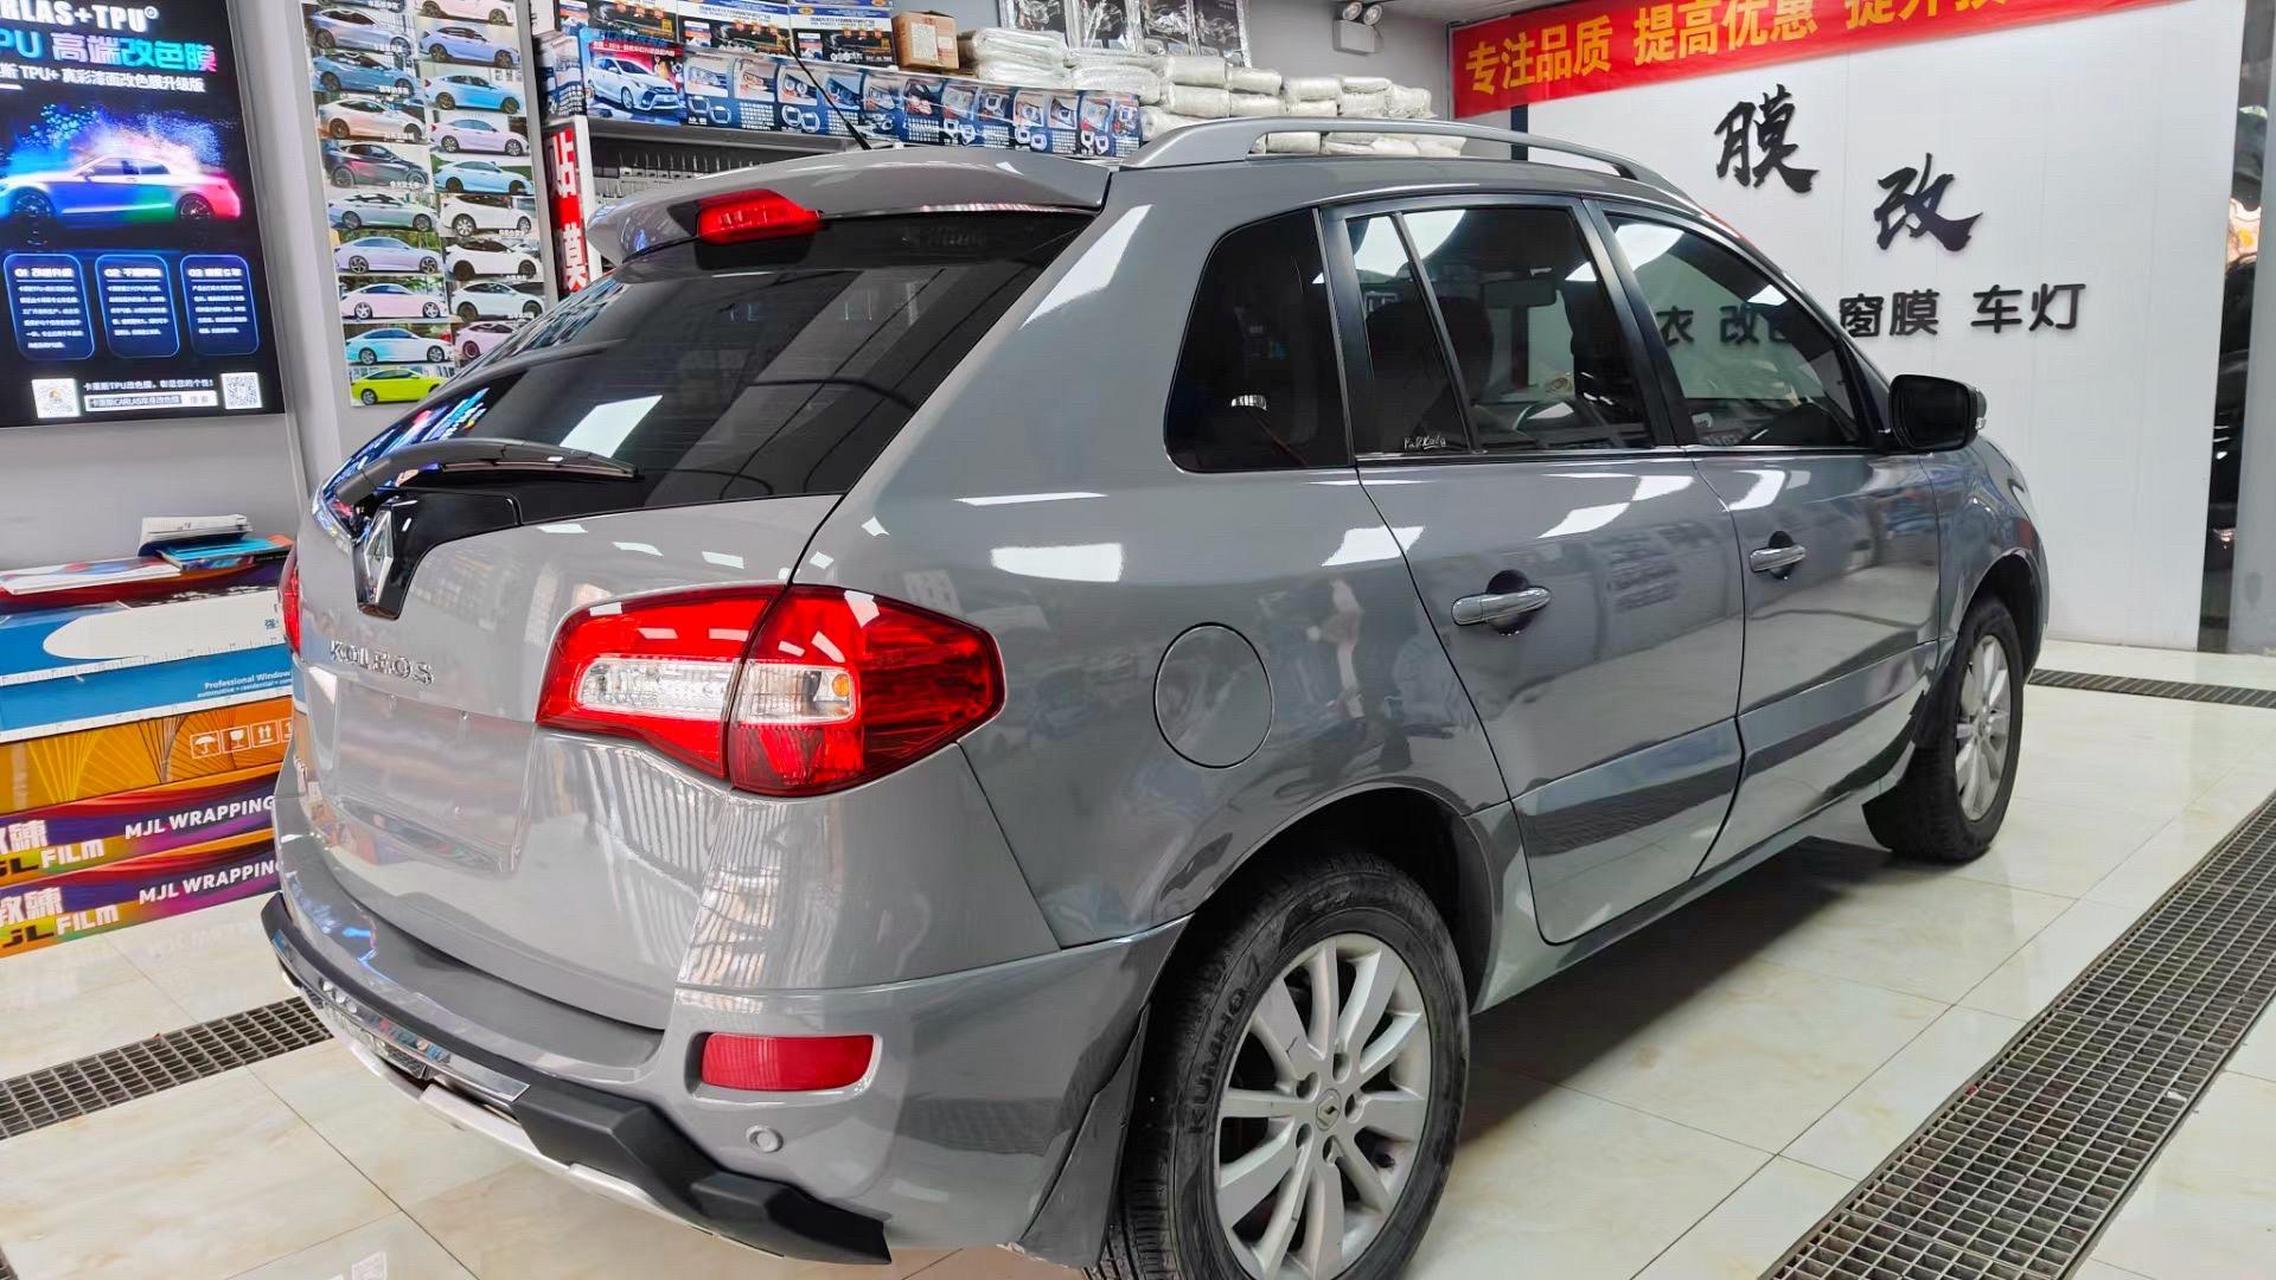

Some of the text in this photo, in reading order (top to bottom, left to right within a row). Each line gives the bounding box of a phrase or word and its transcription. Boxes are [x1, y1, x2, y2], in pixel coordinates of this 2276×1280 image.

[51, 32, 217, 73] 高端改色膜
[1466, 0, 1818, 96] 专注品质 提高优惠
[1838, 288, 1941, 338] 窗膜
[1970, 283, 2086, 334] 车灯
[204, 675, 255, 690] Professional
[124, 794, 276, 840] MJL WRAPPING
[138, 883, 180, 906] MJL
